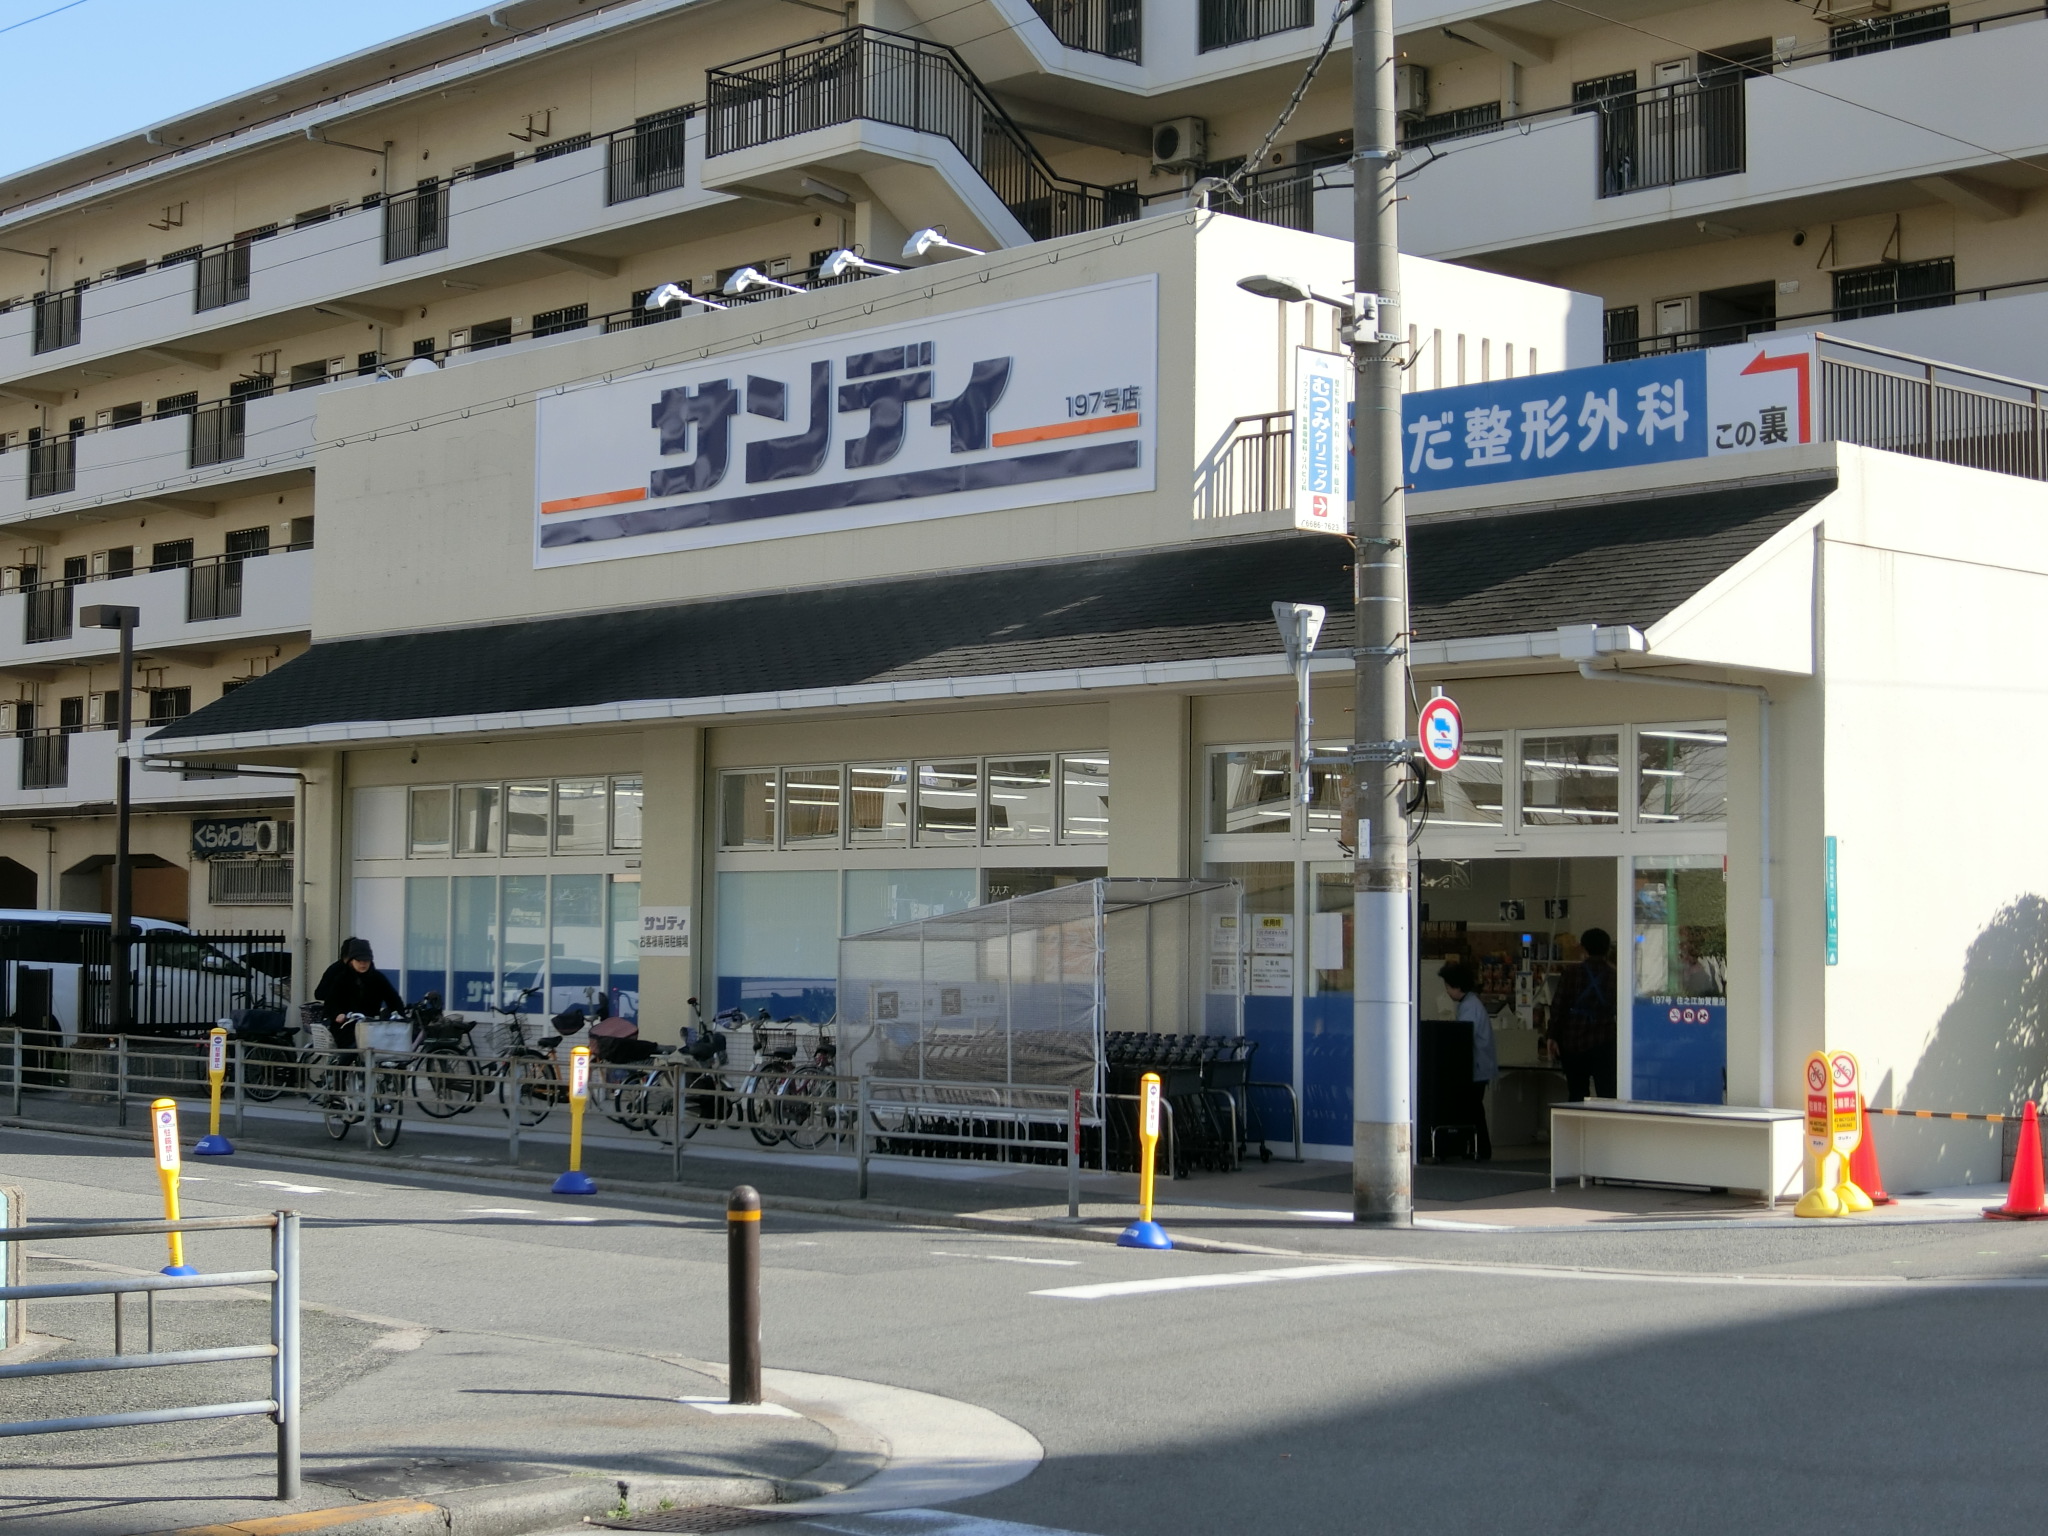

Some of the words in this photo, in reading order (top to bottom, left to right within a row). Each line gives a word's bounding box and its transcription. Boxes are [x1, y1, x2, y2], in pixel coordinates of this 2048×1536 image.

[650, 340, 1013, 498] サンディ
[1065, 385, 1141, 418] 197号店
[1312, 377, 1331, 492] むつみクリニック
[1407, 378, 1690, 474] だ整形外科
[1715, 405, 1788, 450] この裏
[1507, 904, 1518, 920] 6
